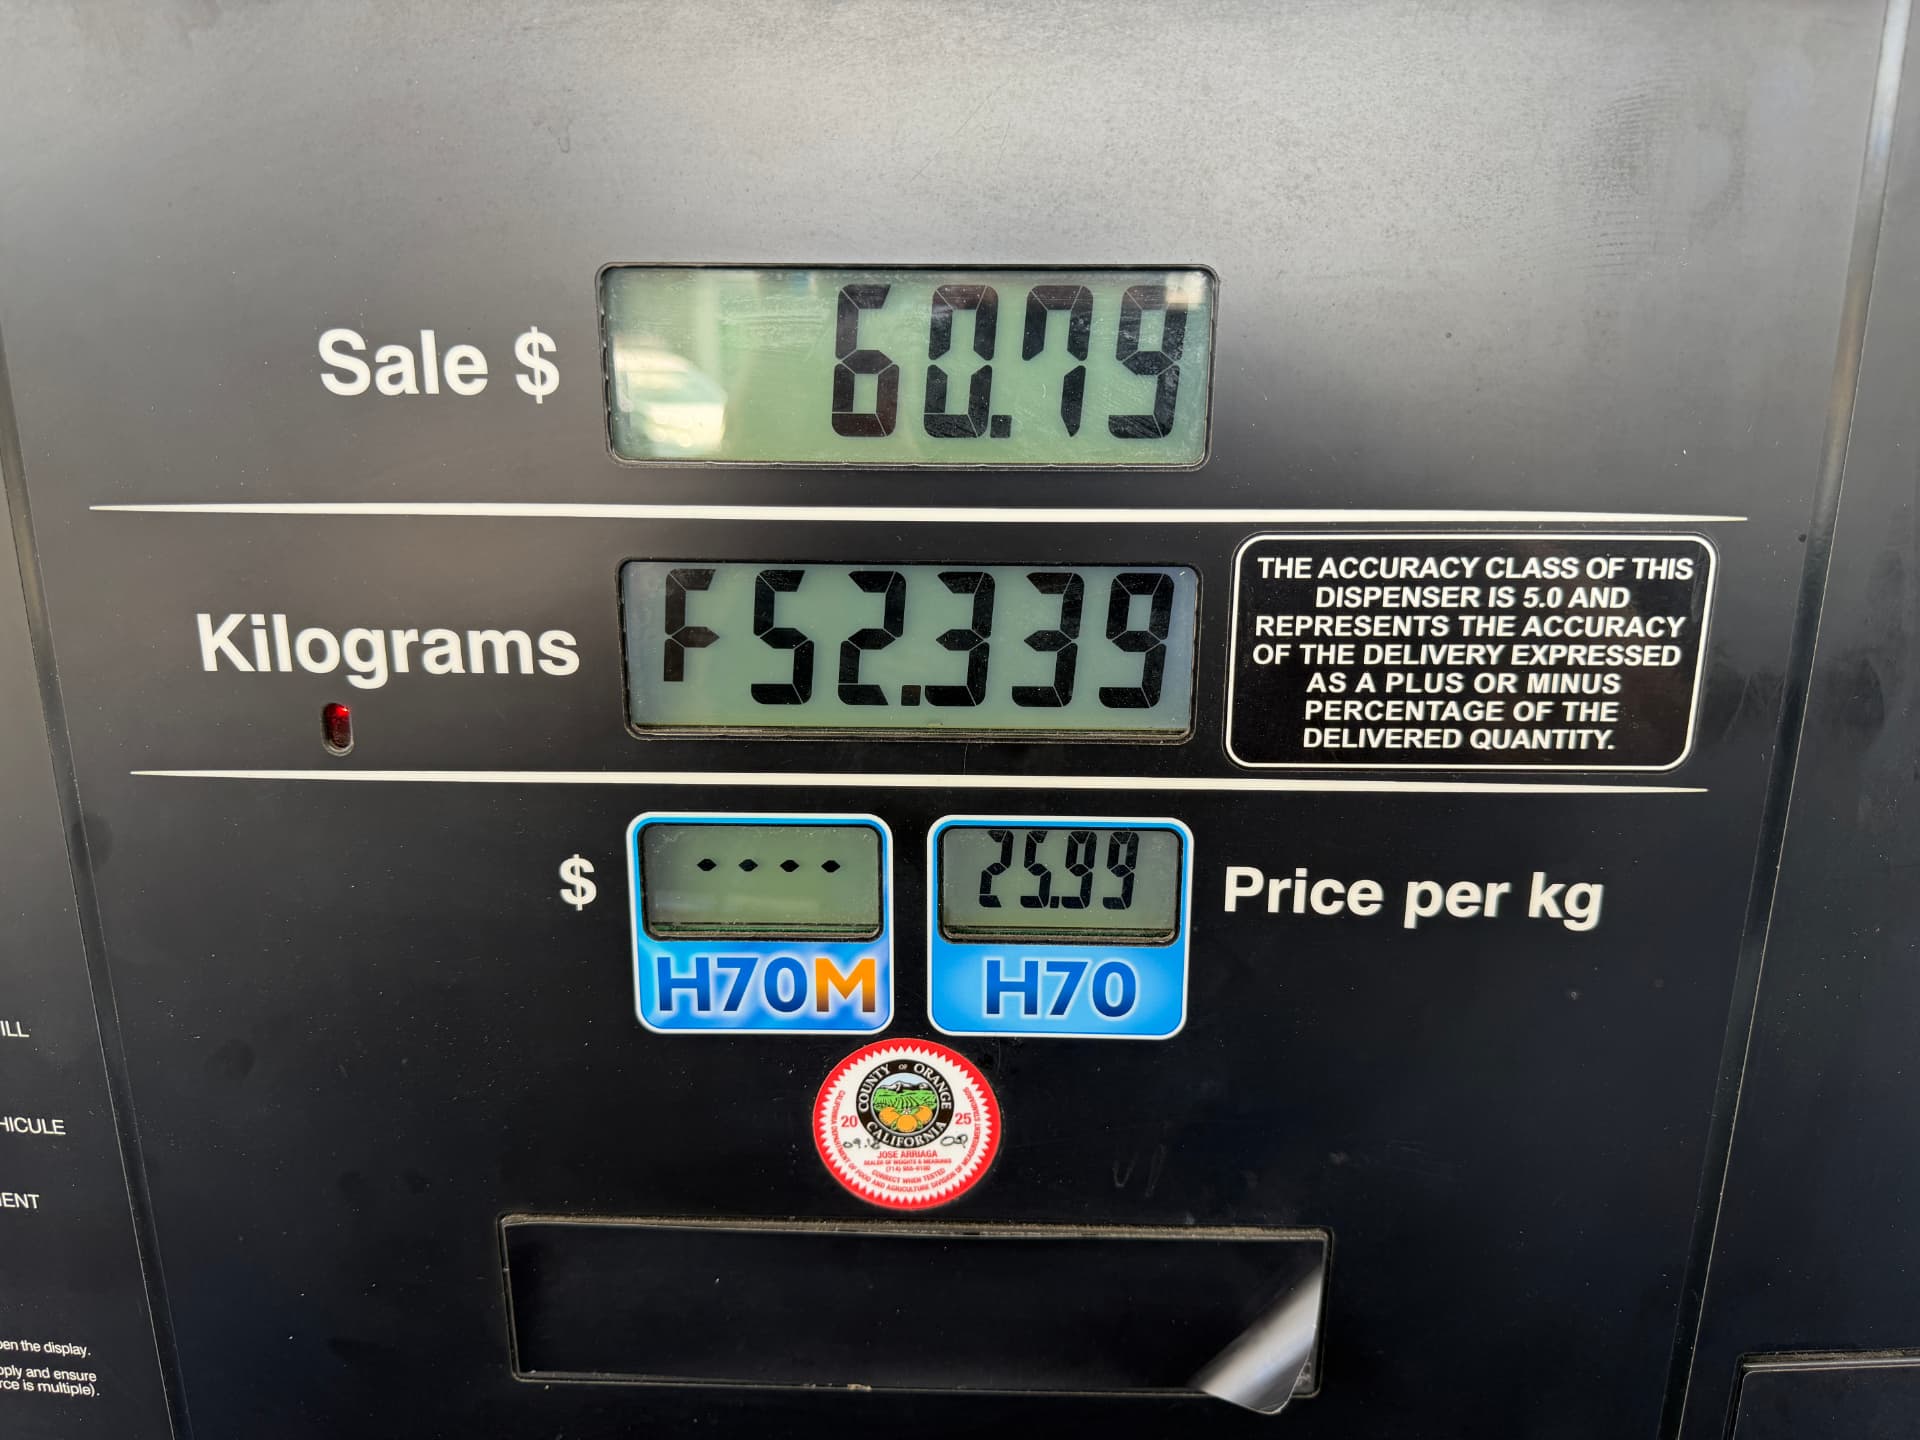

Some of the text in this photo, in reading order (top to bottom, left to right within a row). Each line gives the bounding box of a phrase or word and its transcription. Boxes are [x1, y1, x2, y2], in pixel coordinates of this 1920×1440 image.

[319, 327, 559, 403] Sale $
[832, 284, 1188, 439] 60.79
[1258, 557, 1693, 580] THE ACCURACY CLASS OF THIS
[1316, 586, 1630, 608] DISPENSER IS 5.0 AND
[1256, 615, 1686, 637] REPRESENTS THE ACCURACY
[197, 614, 579, 689] Kilograms
[1253, 644, 1681, 666] OF THE DELIVERY EXPRESSED
[1306, 672, 1621, 694] AS A PLUS OR MINUS
[1305, 700, 1619, 722] PERCENTAGE OF THE
[1304, 728, 1614, 750] DELIVERED QUANTITY.
[978, 830, 1139, 909] 25.99
[560, 854, 596, 910] $
[1225, 867, 1603, 931] Price per kg
[657, 955, 875, 1013] H70M
[985, 959, 1136, 1017] H70
[858, 1063, 890, 1112] COUNTY
[913, 1063, 951, 1110] ORANGE
[840, 1115, 858, 1128] 20
[954, 1112, 972, 1125] 25
[866, 1121, 947, 1147] CALIFORNIA
[21, 1340, 40, 1352] the
[44, 1341, 91, 1358] display.
[26, 1368, 50, 1378] and
[54, 1371, 96, 1382] ensure
[23, 1379, 34, 1391] is
[37, 1380, 100, 1397] multiple).
